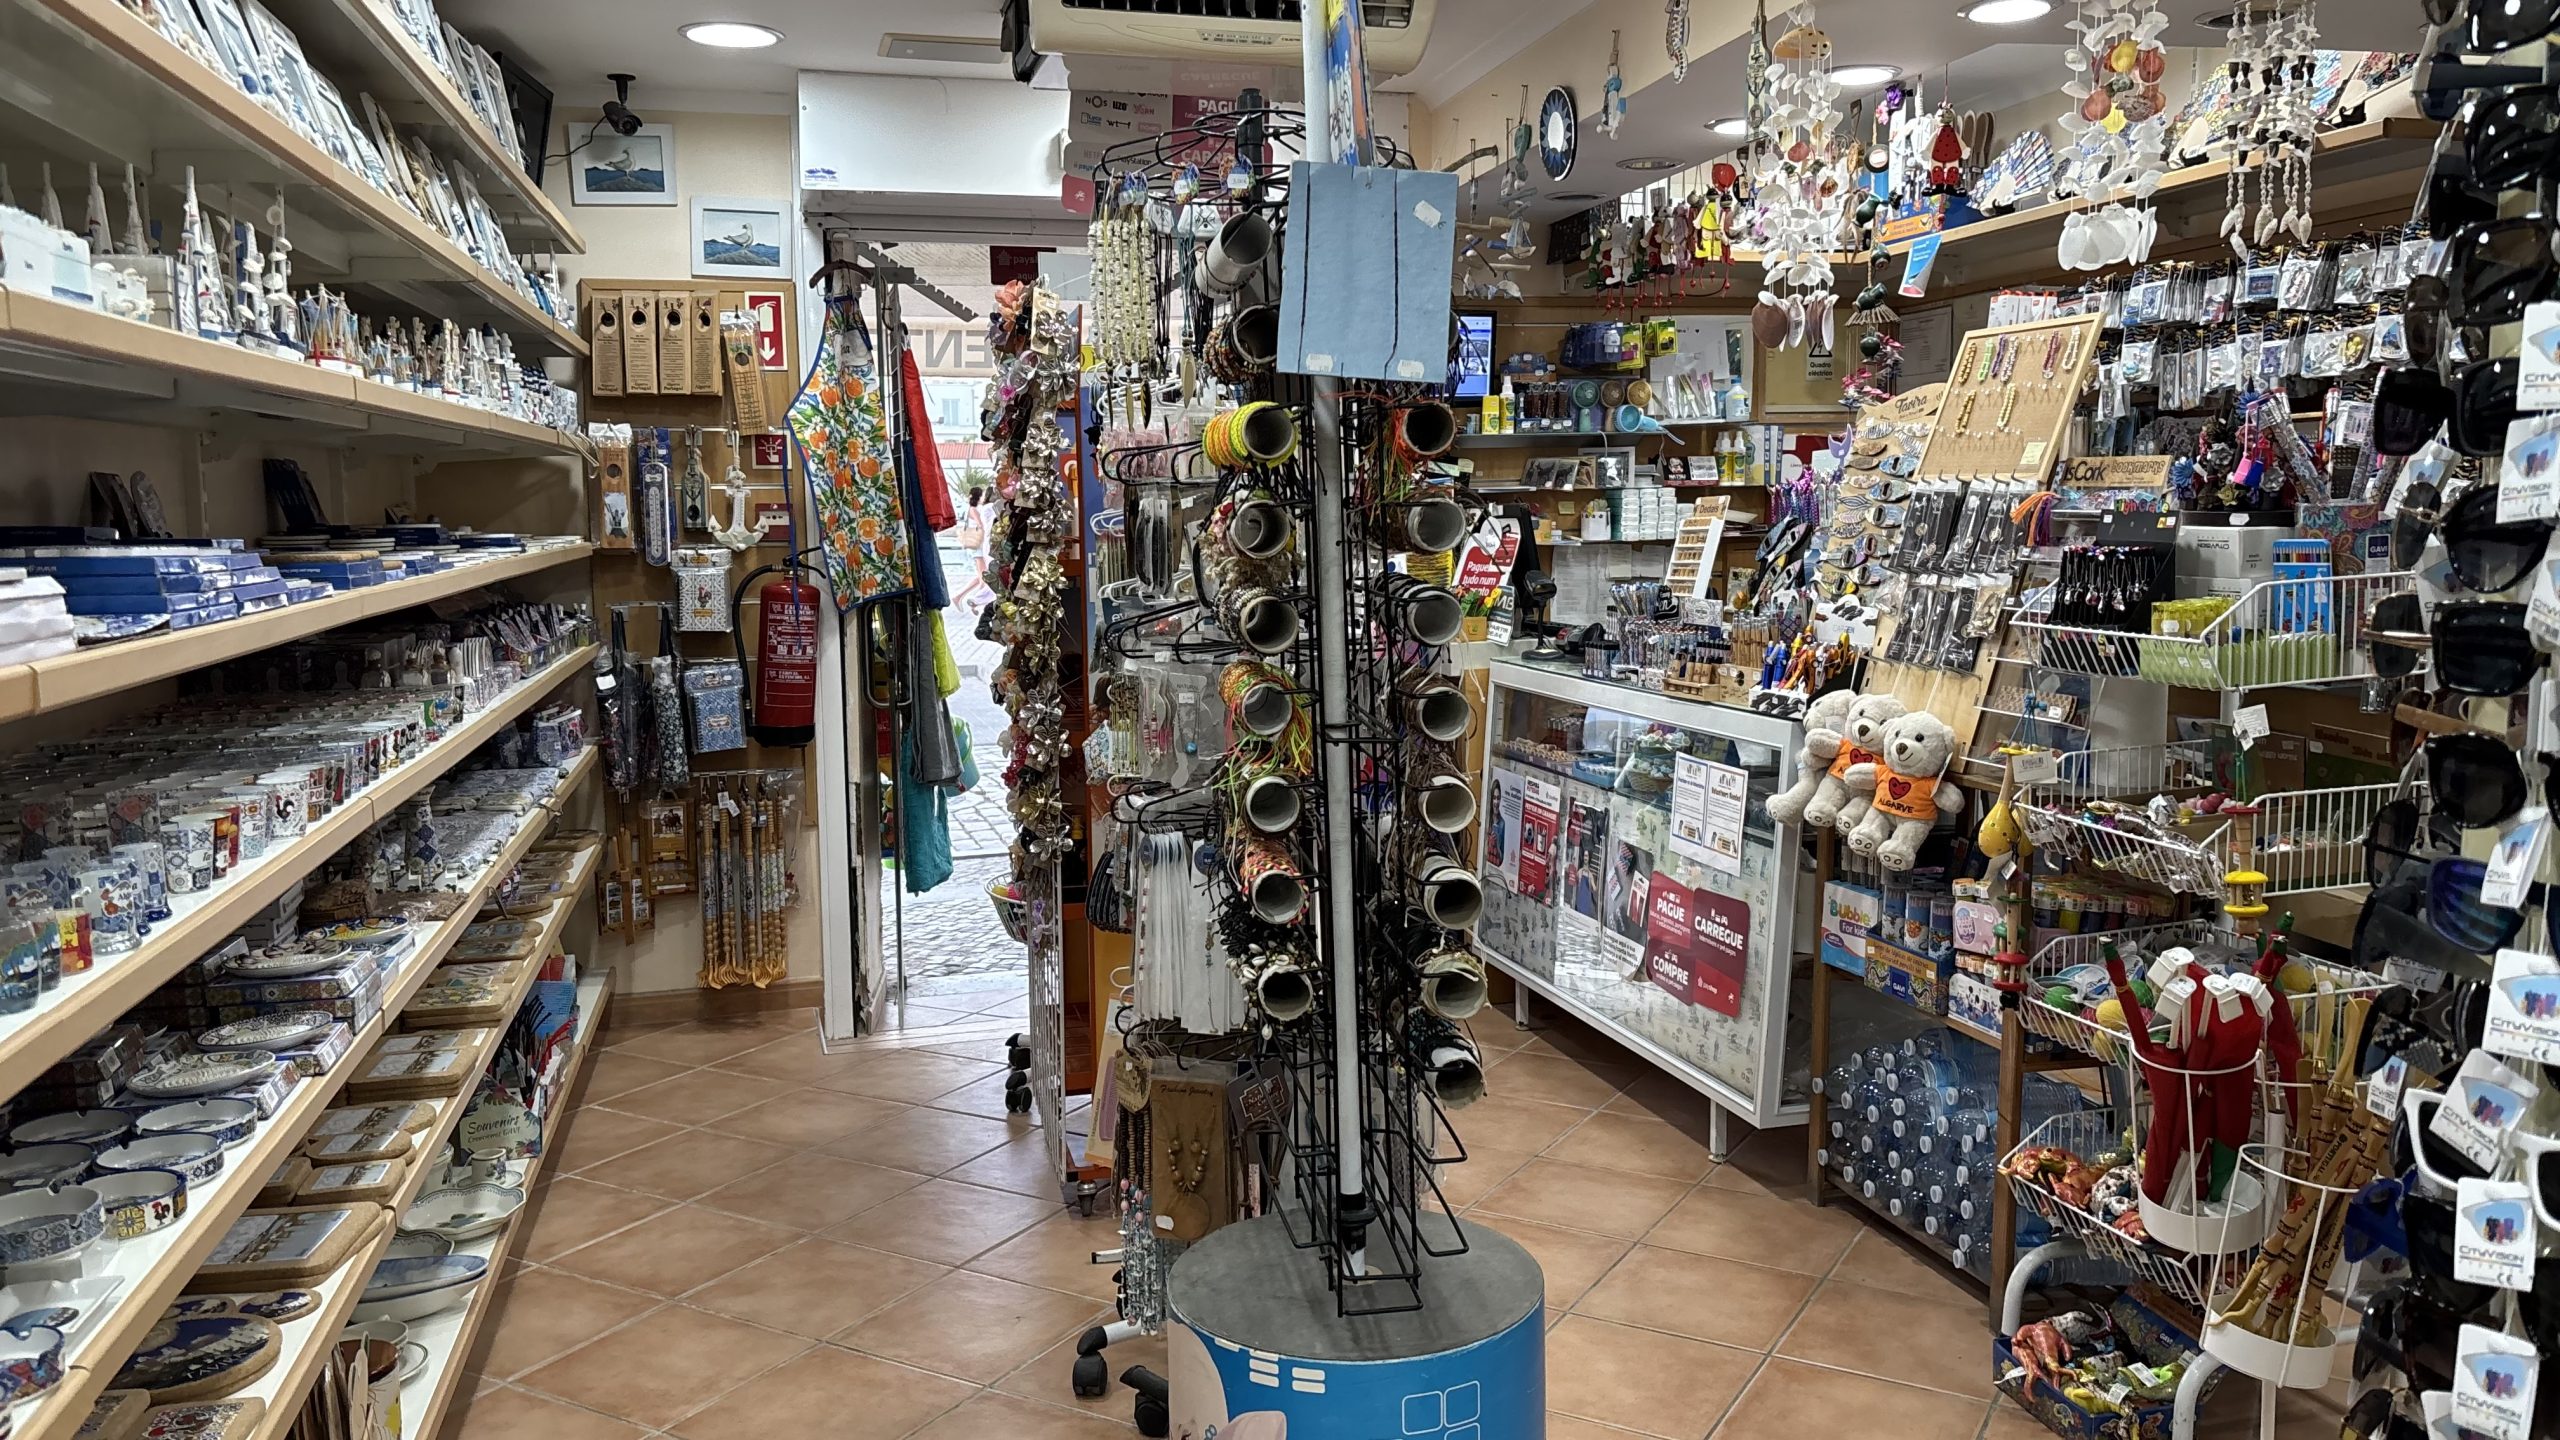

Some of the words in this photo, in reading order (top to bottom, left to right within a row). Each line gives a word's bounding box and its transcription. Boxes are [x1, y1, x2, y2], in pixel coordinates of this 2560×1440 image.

[1086, 96, 1108, 108] NOS
[1198, 99, 1238, 114] PAGU
[1106, 120, 1131, 130] wtf
[1895, 394, 1928, 414] Tavira
[1700, 504, 1720, 514] Dedais
[2114, 498, 2137, 516] High
[2138, 498, 2170, 514] Grade
[2369, 546, 2388, 554] GAVI
[1480, 576, 1496, 586] num
[1878, 798, 1914, 814] ALGARVE
[252, 822, 265, 832] Tav
[202, 852, 212, 862] Ta
[1656, 897, 1686, 922] PAGUE
[1829, 899, 1870, 926] Bubble
[1694, 916, 1744, 950] CARREGUE
[1842, 924, 1853, 934] For
[1854, 926, 1867, 937] kids
[1652, 955, 1689, 986] COMPRE
[467, 1114, 520, 1135] Souvenirs
